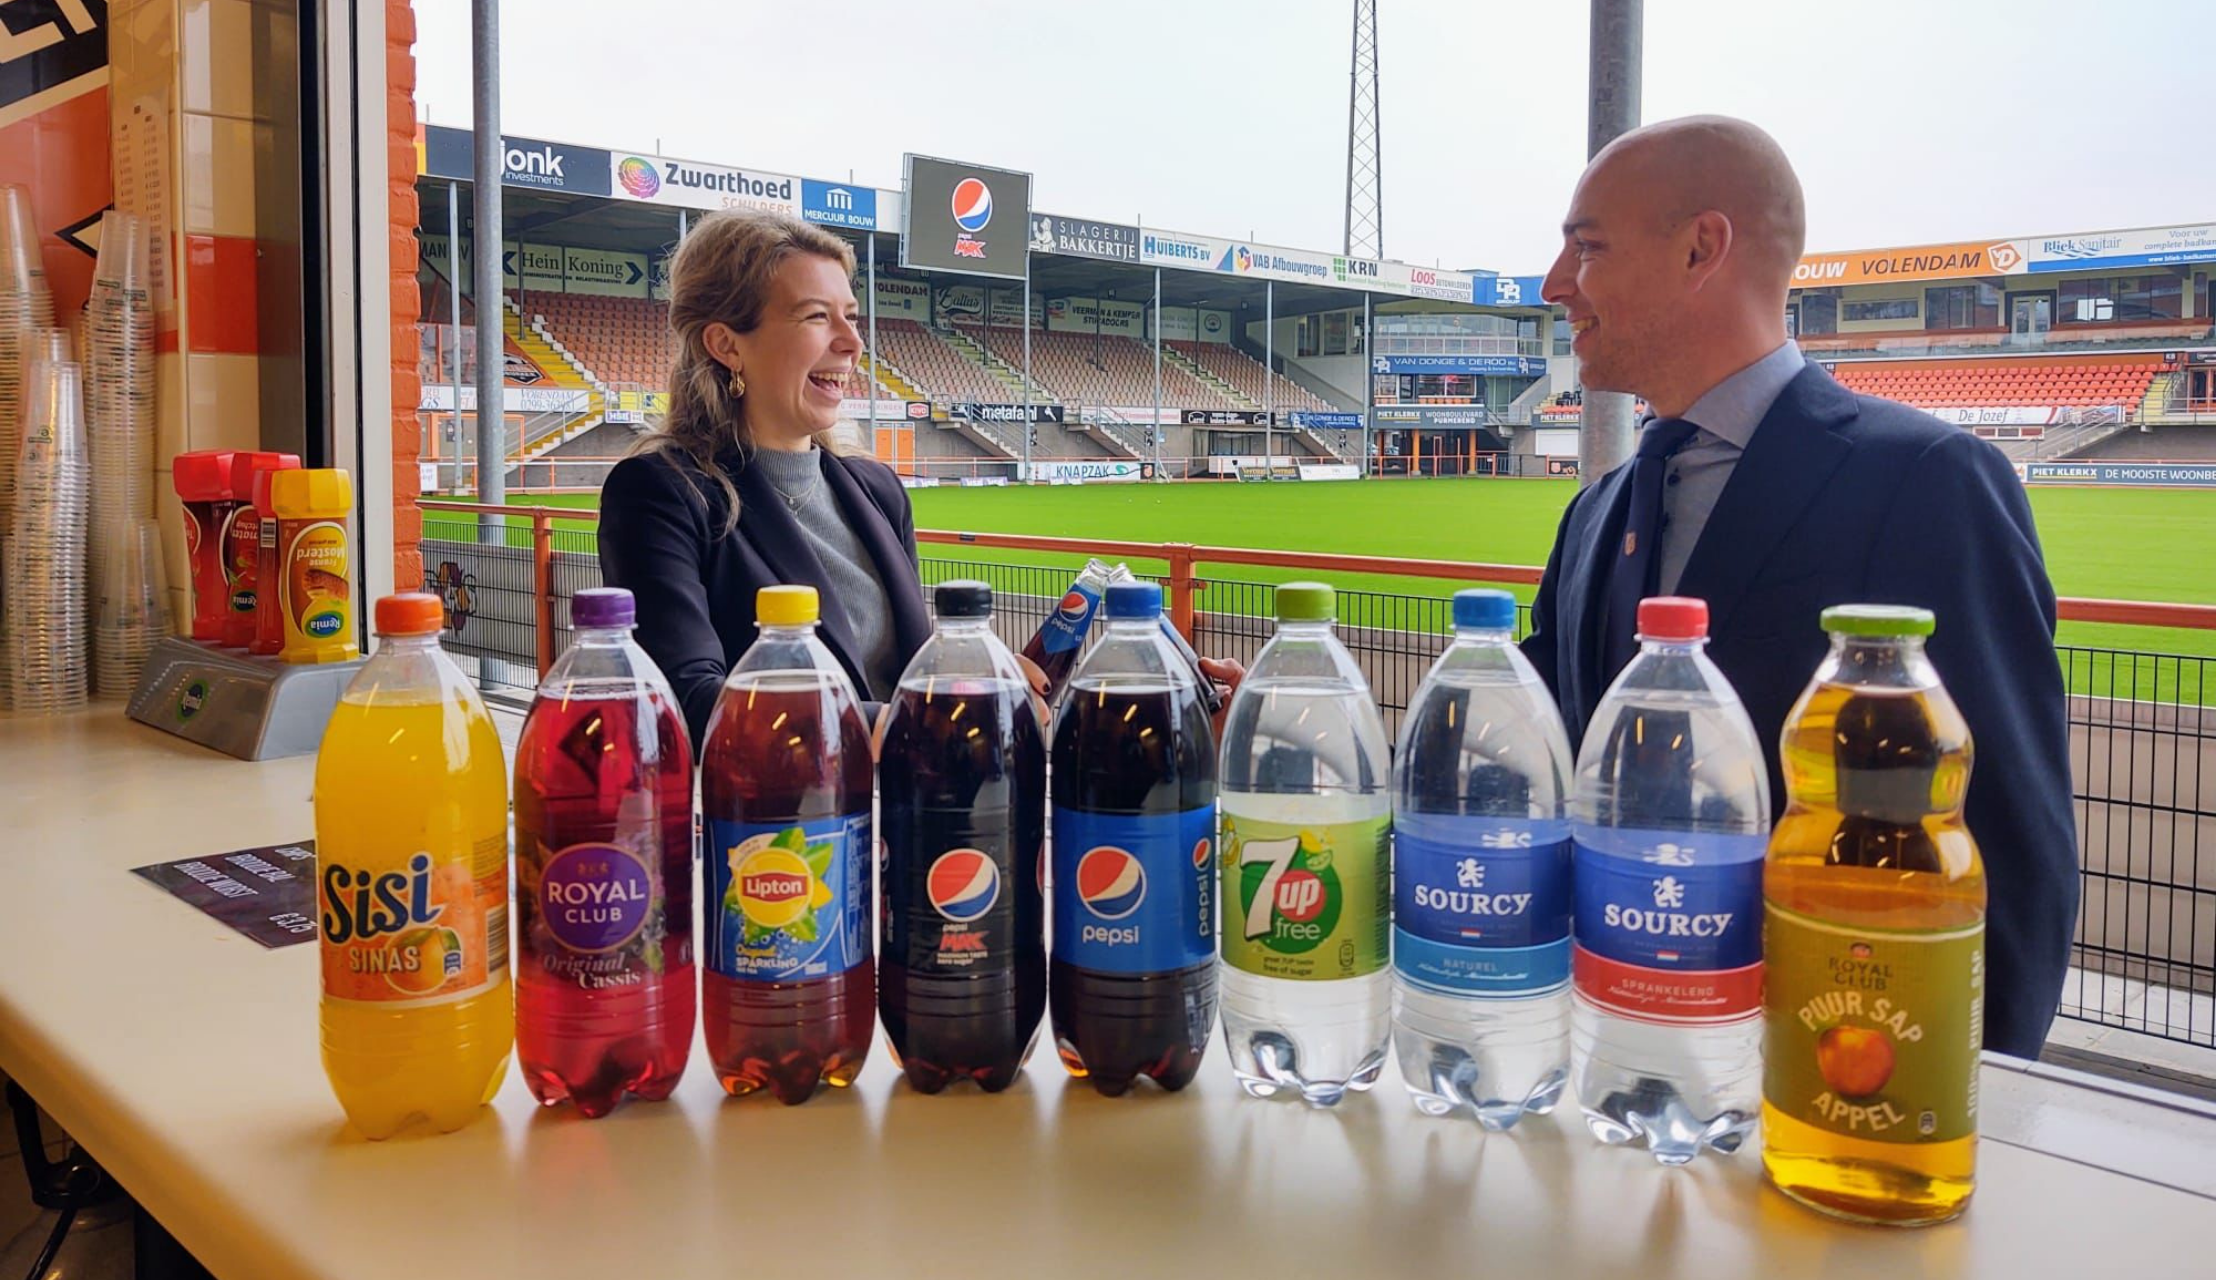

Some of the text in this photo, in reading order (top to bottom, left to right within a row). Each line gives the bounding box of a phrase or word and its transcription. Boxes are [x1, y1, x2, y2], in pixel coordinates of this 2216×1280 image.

[501, 139, 564, 177] jonk
[505, 170, 564, 186] investments
[665, 162, 792, 200] Zwarthoed
[804, 209, 875, 227] MERCUUR BOUW
[1059, 220, 1136, 244] SLAGERIJ
[2169, 229, 2209, 239] Voor uw
[1059, 235, 1136, 260] BAKKERTJE
[1143, 235, 1212, 261] HUIBERTS BV
[2043, 236, 2123, 253] Bliek Sanitair
[2144, 240, 2183, 251] complete
[521, 251, 624, 279] Hein Koning
[1252, 251, 1328, 279] VAB Afbouwgroep
[1348, 259, 1378, 277] KRN
[1862, 252, 1982, 276] VOLENDAM
[1410, 268, 1436, 286] LOOS
[1394, 357, 1416, 366] VAN
[1419, 357, 1456, 366] DONGE
[1458, 357, 1466, 366] &
[1425, 411, 1484, 419] WOONBOULEVARD
[1958, 408, 2010, 424] De Jozef
[1056, 464, 1110, 478] KNAPZAK
[2032, 467, 2055, 476] PIET
[2056, 467, 2098, 477] KLERKX
[2105, 468, 2119, 479] DE
[2120, 468, 2168, 480] MOOISTE
[296, 547, 346, 562] Mosterd
[310, 614, 341, 630] Remia
[1051, 617, 1076, 634] pepsi
[547, 878, 646, 905] ROYAL
[746, 877, 803, 898] Lipton
[1197, 874, 1211, 937] pepsi
[1414, 884, 1533, 916] SOURCY
[565, 907, 623, 923] CLUB
[1604, 903, 1733, 937] SOURCY
[1082, 924, 1140, 947] pepsi
[1275, 917, 1322, 940] free
[939, 930, 991, 952] MAX
[350, 945, 421, 974] SINAS
[543, 951, 626, 977] Original
[736, 956, 799, 969] SPARKLING
[1442, 957, 1498, 973] NATUREL
[1828, 956, 1894, 978] ROYAL
[578, 967, 642, 990] Cassis
[1621, 978, 1716, 997] SPRANKELEND
[1834, 972, 1887, 991] CLUB
[1798, 990, 1924, 1044] PUUR SAP
[1811, 1091, 1907, 1132] APPEL
